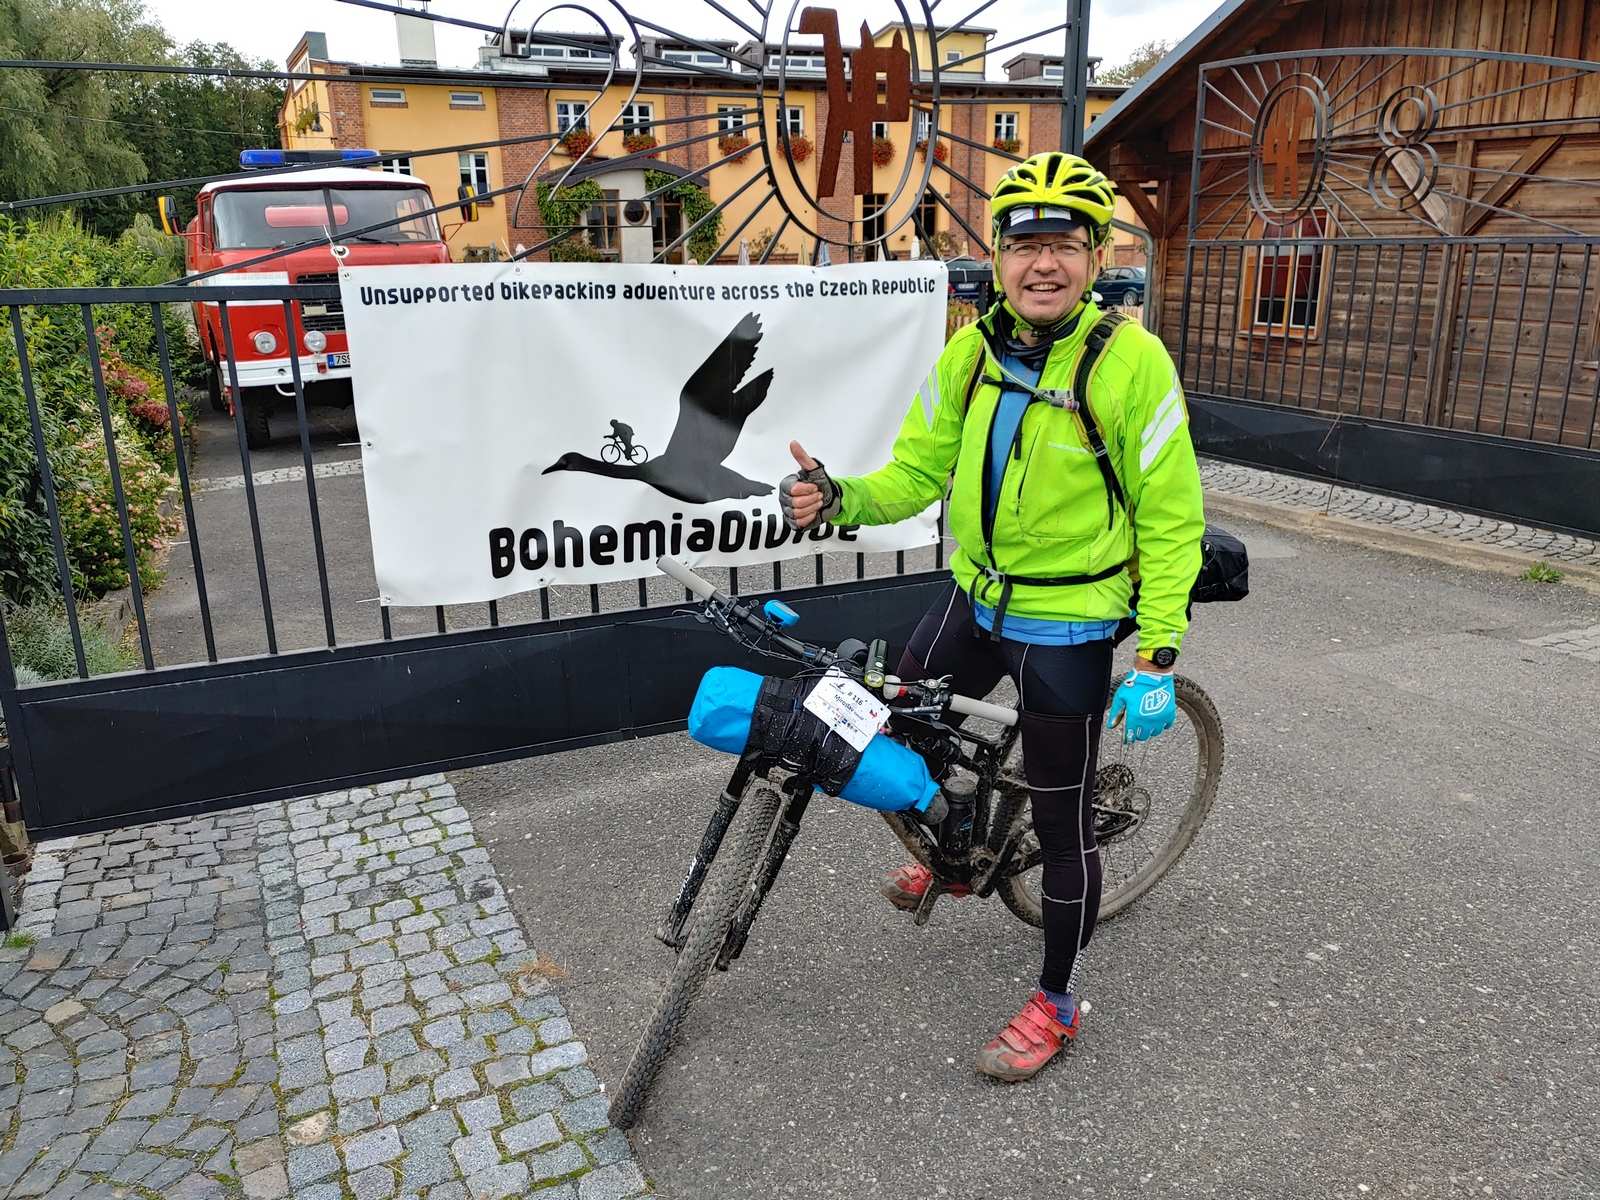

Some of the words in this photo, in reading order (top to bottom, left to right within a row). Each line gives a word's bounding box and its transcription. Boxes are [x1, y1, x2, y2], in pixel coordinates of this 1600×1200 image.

[360, 282, 495, 306] Unsupported
[500, 281, 616, 301] bikepacking
[622, 282, 716, 301] adventure
[721, 285, 780, 301] across
[784, 281, 815, 298] the
[819, 279, 868, 297] Czech
[872, 276, 936, 296] Republic
